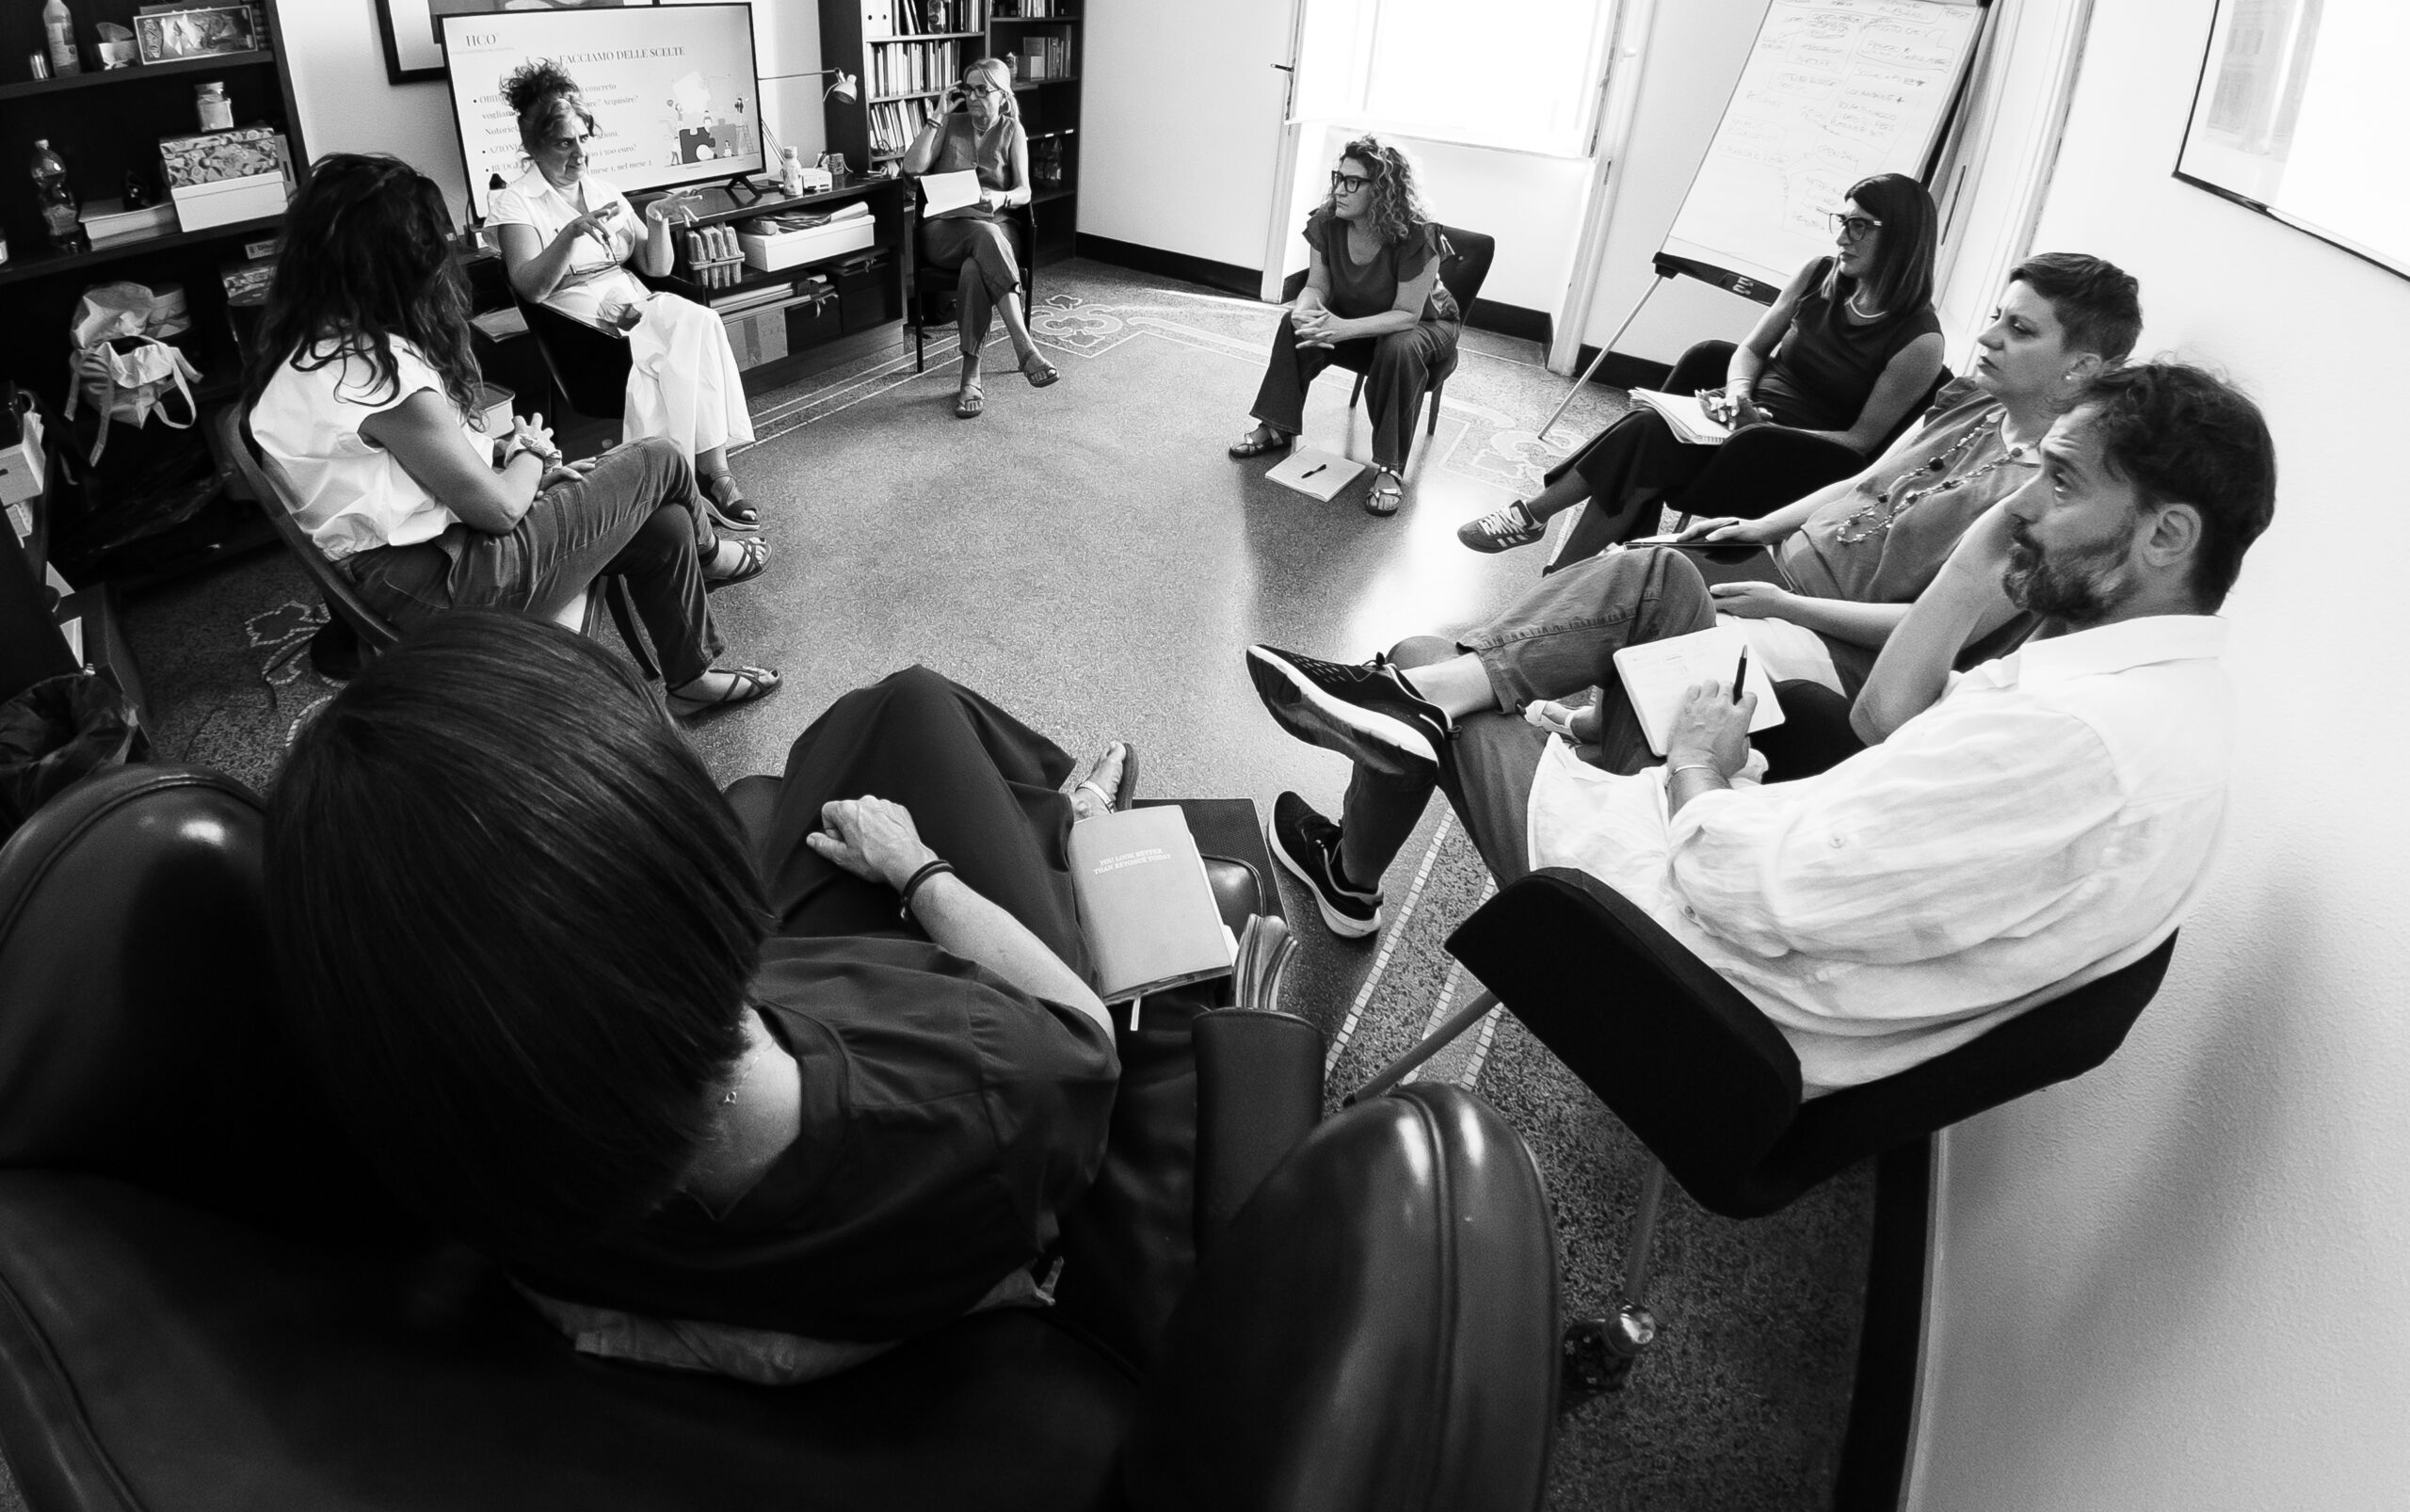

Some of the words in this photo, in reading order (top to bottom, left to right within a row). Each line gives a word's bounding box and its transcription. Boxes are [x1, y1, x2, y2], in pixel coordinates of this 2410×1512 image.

[559, 52, 615, 67] FACCIAMO
[616, 49, 648, 60] DELLE
[650, 46, 685, 57] SCELTE
[585, 83, 617, 93] concreto
[603, 95, 638, 106] Acquisire?
[483, 124, 519, 135] Notoriet
[618, 144, 637, 153] euro?
[617, 162, 628, 171] nel
[629, 160, 648, 169] mese
[1099, 857, 1114, 866] YOU
[1116, 852, 1135, 861] LOOK
[1135, 848, 1163, 858] BETTER
[1093, 864, 1114, 876] THAN
[1148, 853, 1171, 863] TODAY
